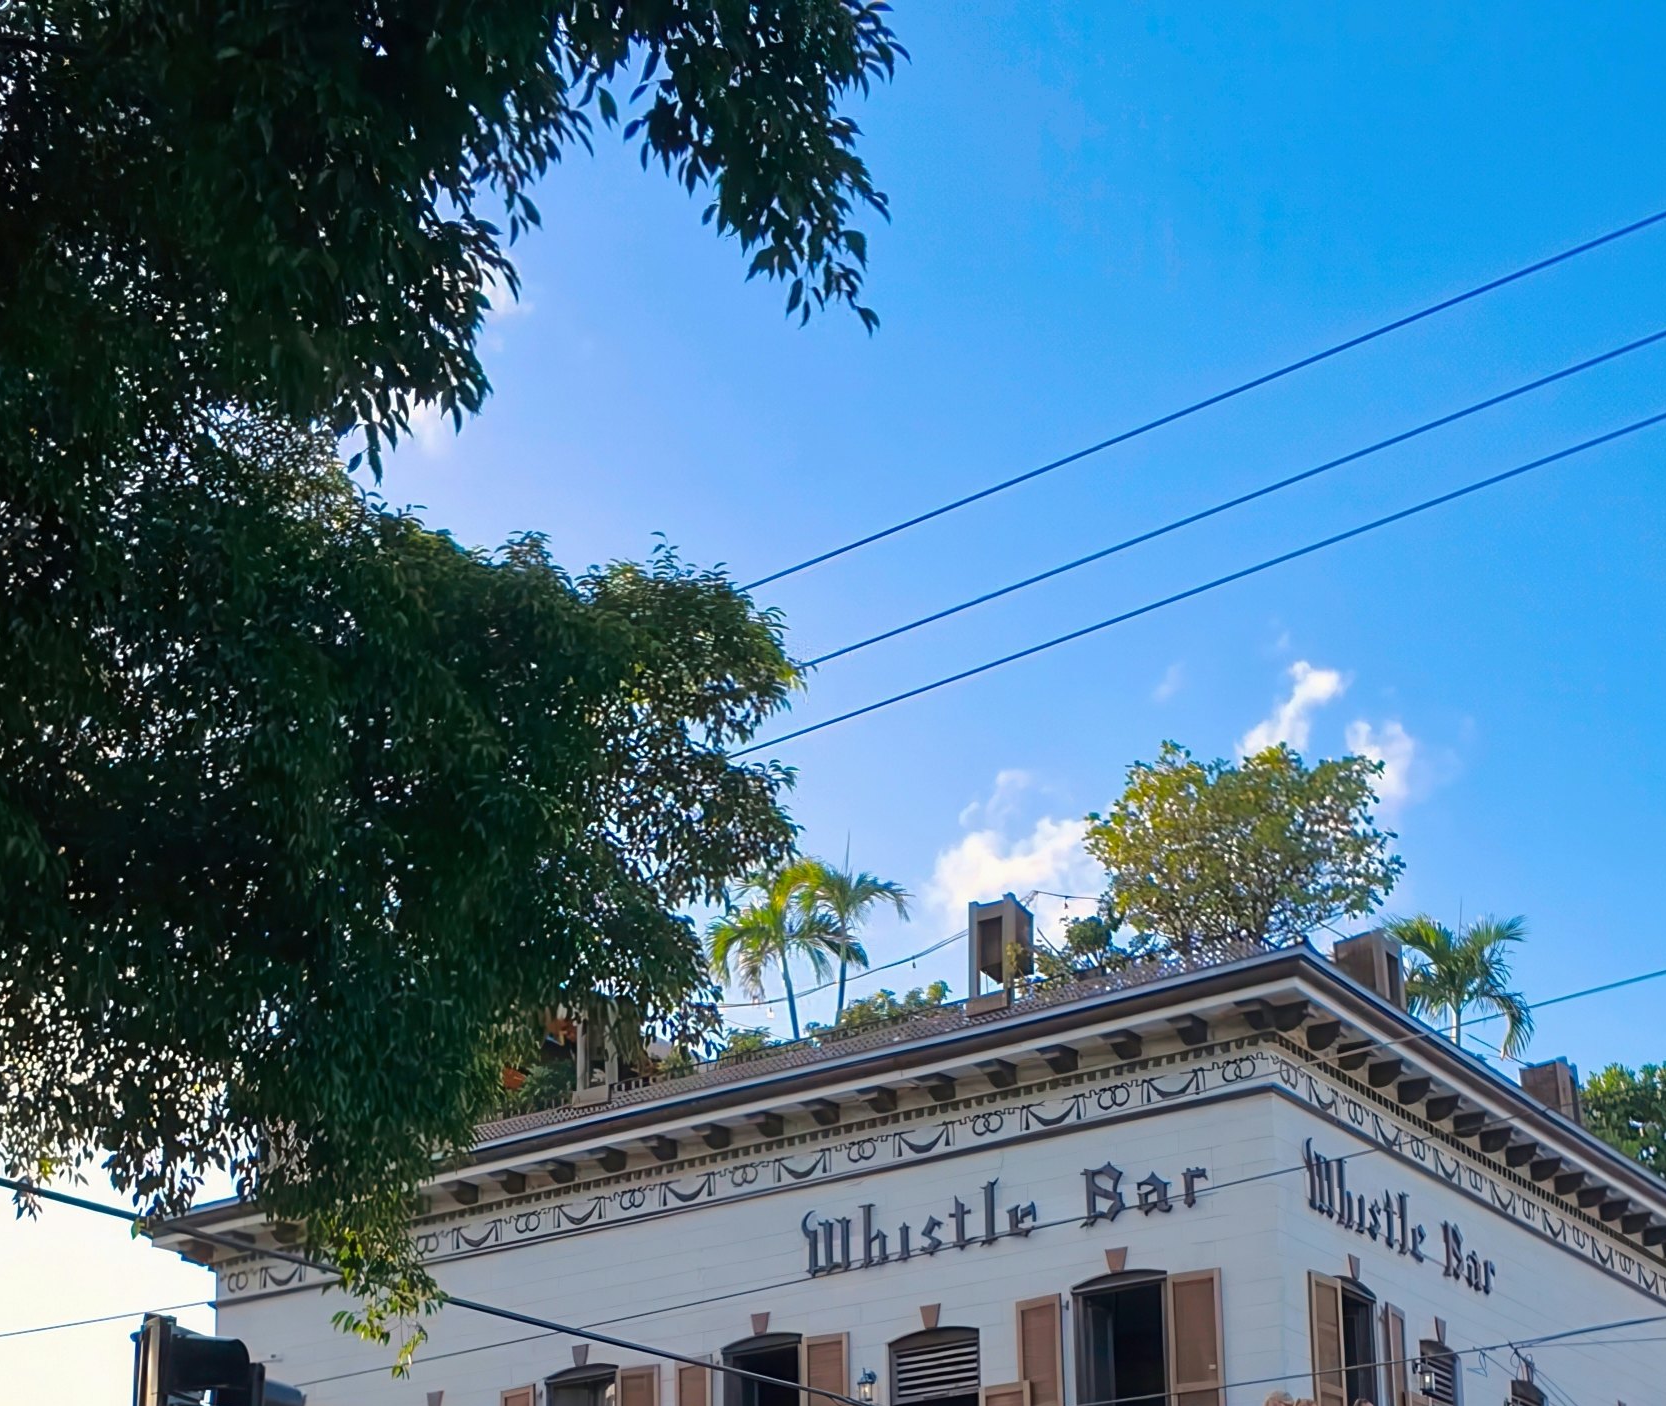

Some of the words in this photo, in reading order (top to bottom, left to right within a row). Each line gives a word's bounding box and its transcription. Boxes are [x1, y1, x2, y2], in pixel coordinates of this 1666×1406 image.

[800, 1176, 1037, 1278] Whistle
[1080, 1160, 1209, 1229] Bar
[1303, 1136, 1427, 1264] Whistle
[1440, 1219, 1497, 1296] Bar
